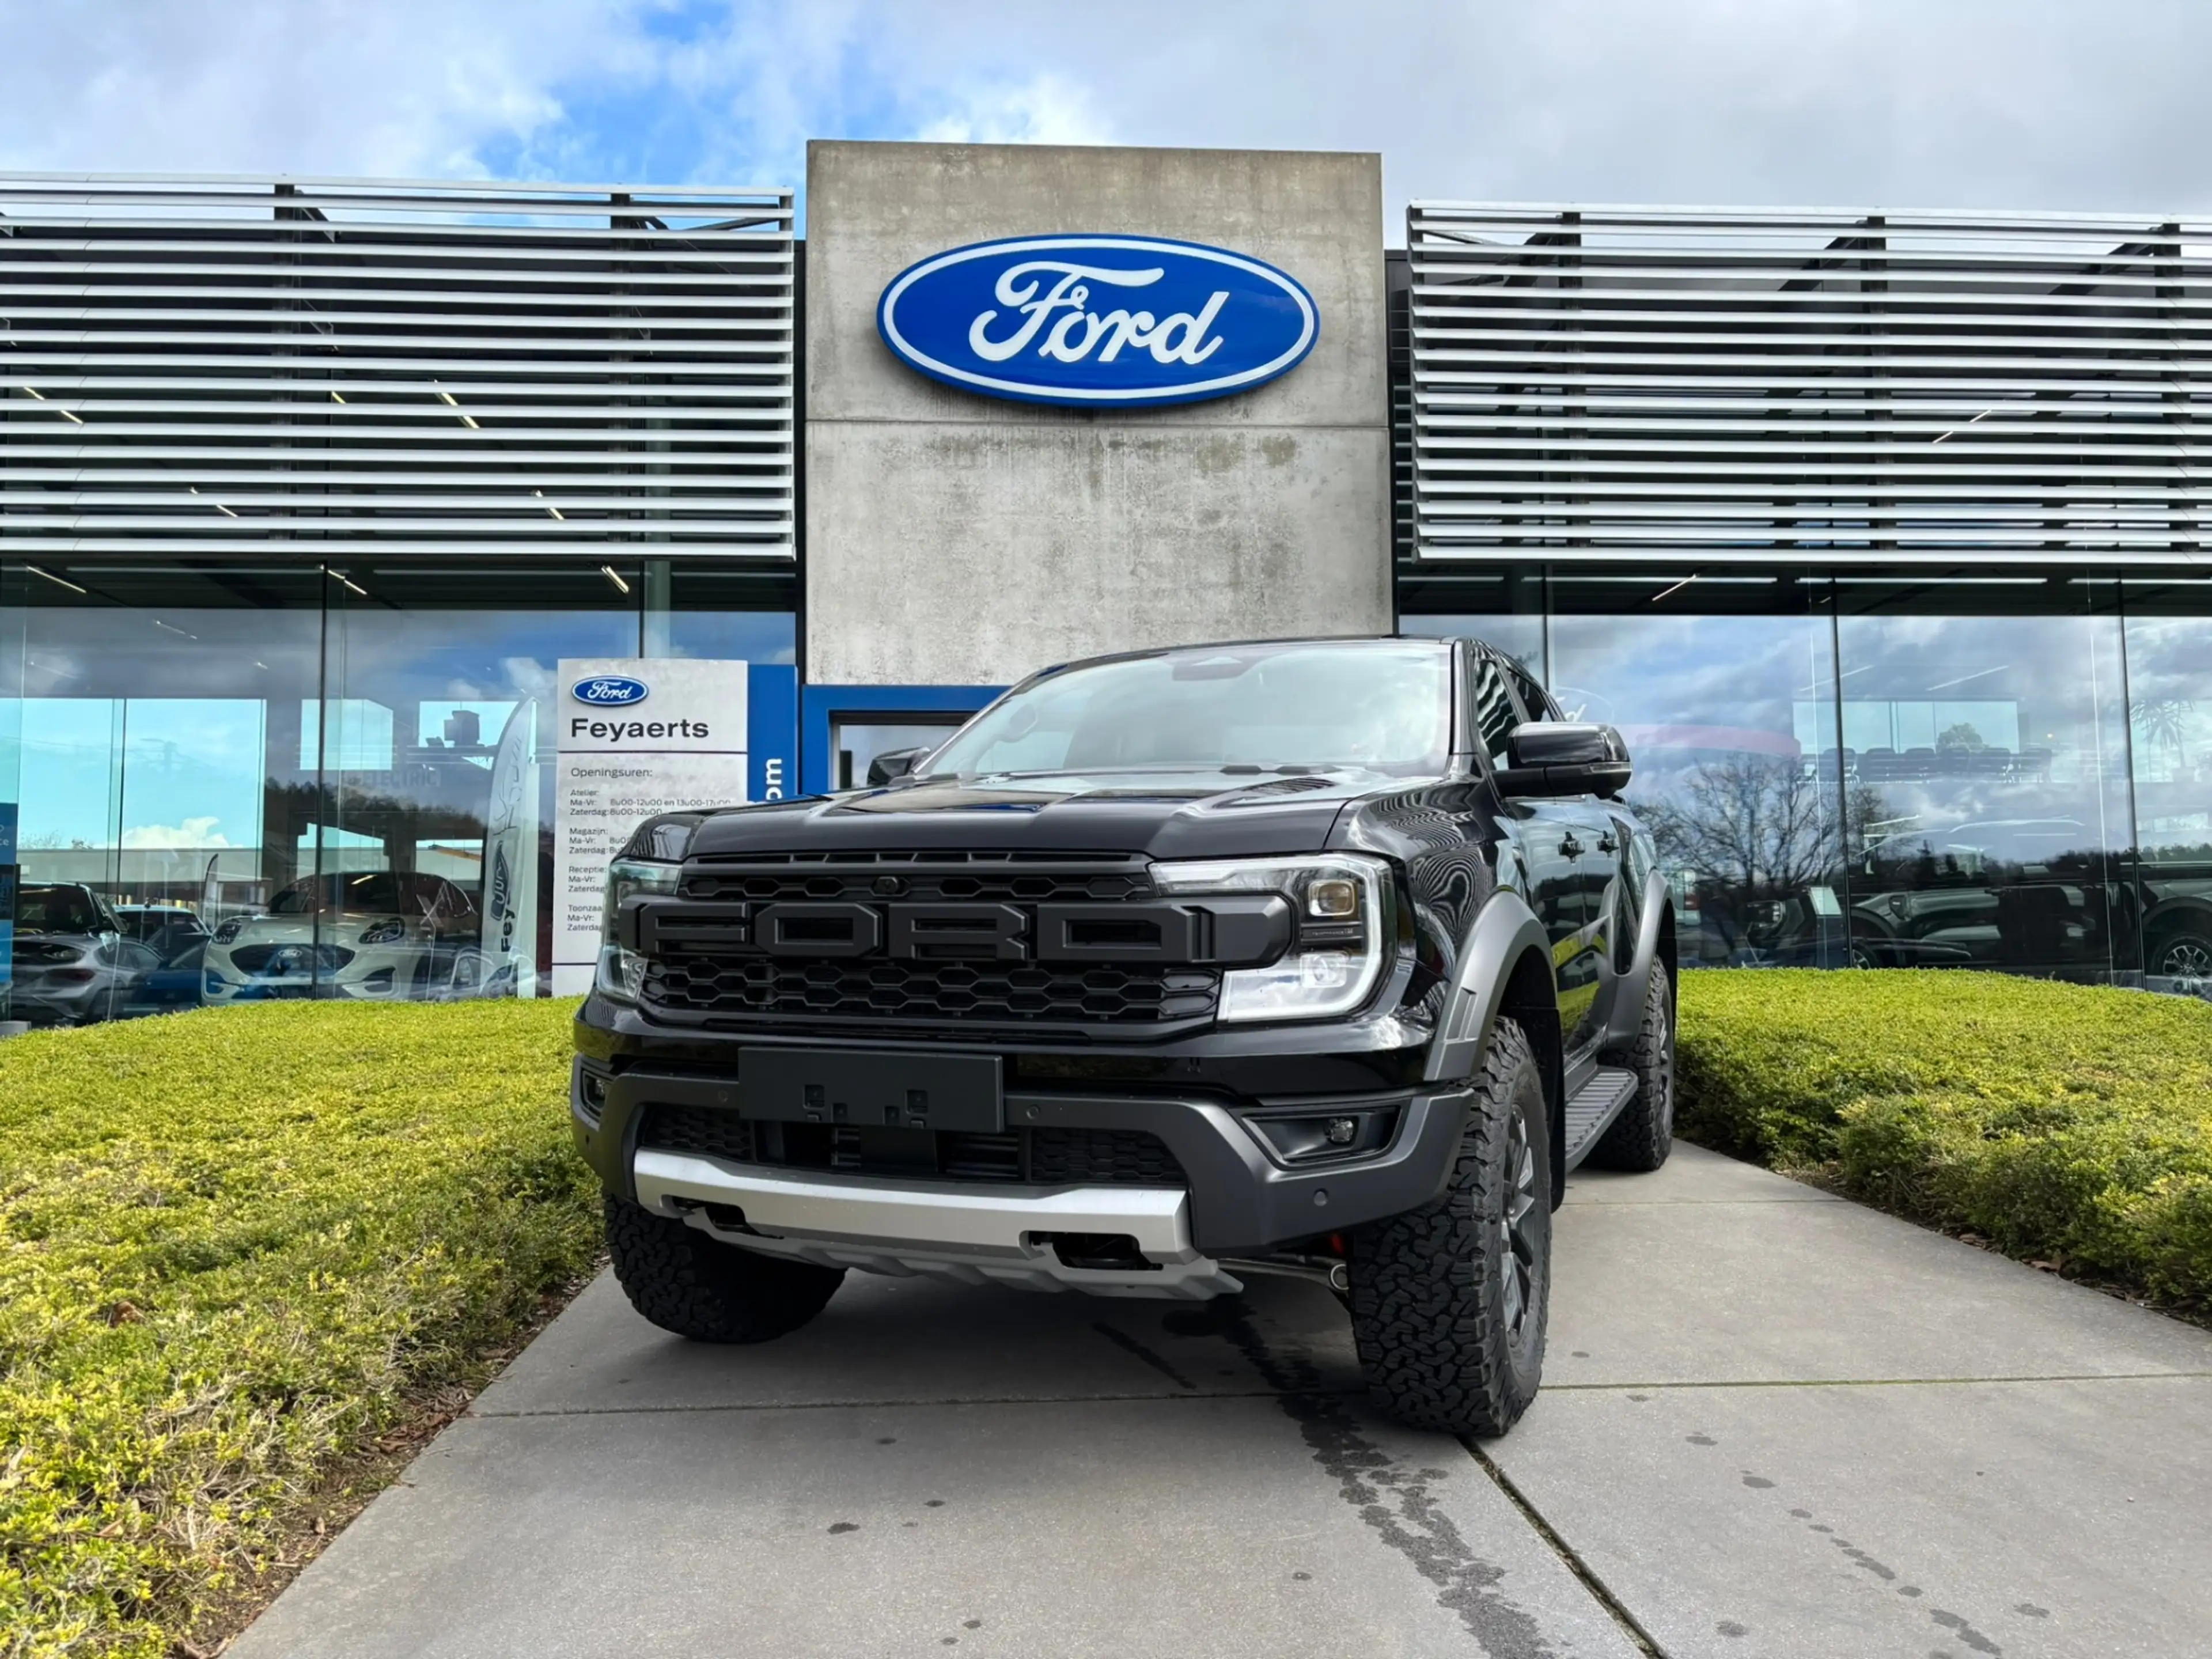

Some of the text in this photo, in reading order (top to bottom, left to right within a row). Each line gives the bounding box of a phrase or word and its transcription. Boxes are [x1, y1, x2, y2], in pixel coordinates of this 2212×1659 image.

[969, 261, 1229, 365] Ford
[587, 680, 634, 699] Ford
[571, 718, 710, 743] Feyaerts
[570, 767, 653, 779] Openingsuren:
[570, 808, 609, 817] Zaterdag:
[569, 827, 608, 836] Magazijn:
[569, 846, 608, 855] Zaterdag:
[639, 900, 1197, 963] FORD
